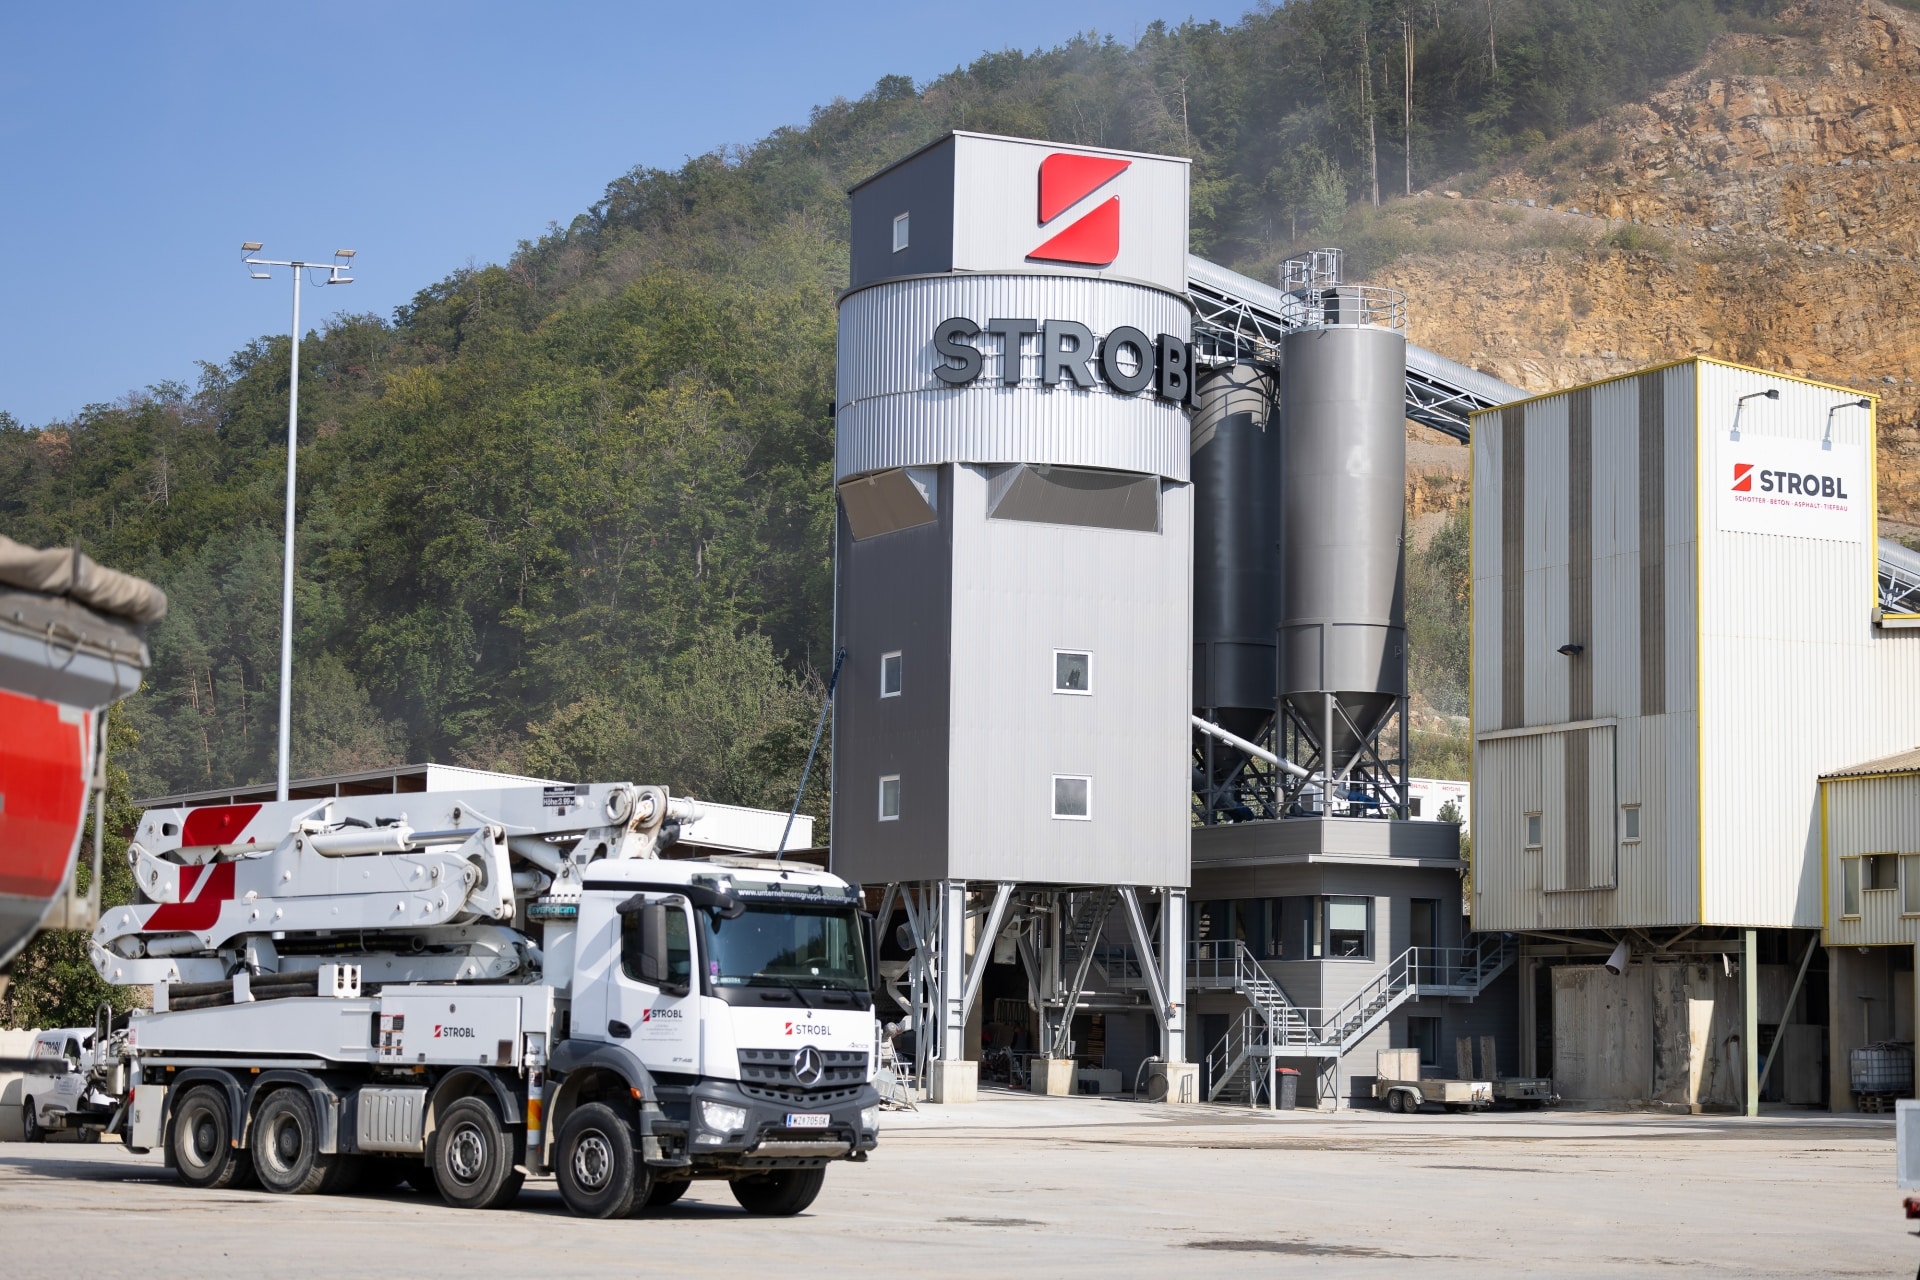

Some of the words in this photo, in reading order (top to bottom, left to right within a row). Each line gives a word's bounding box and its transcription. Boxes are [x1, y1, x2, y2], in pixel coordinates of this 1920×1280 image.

[933, 317, 1202, 411] STROBL
[1760, 470, 1848, 499] STROBL
[1734, 495, 1766, 504] SCHOTTER
[1770, 498, 1790, 506] BETON
[1794, 501, 1820, 509] ASPHALT
[1824, 503, 1848, 512] TIEFBAU
[652, 1009, 683, 1018] STROBL
[443, 1027, 475, 1038] STROBL
[796, 1024, 831, 1036] STROBL
